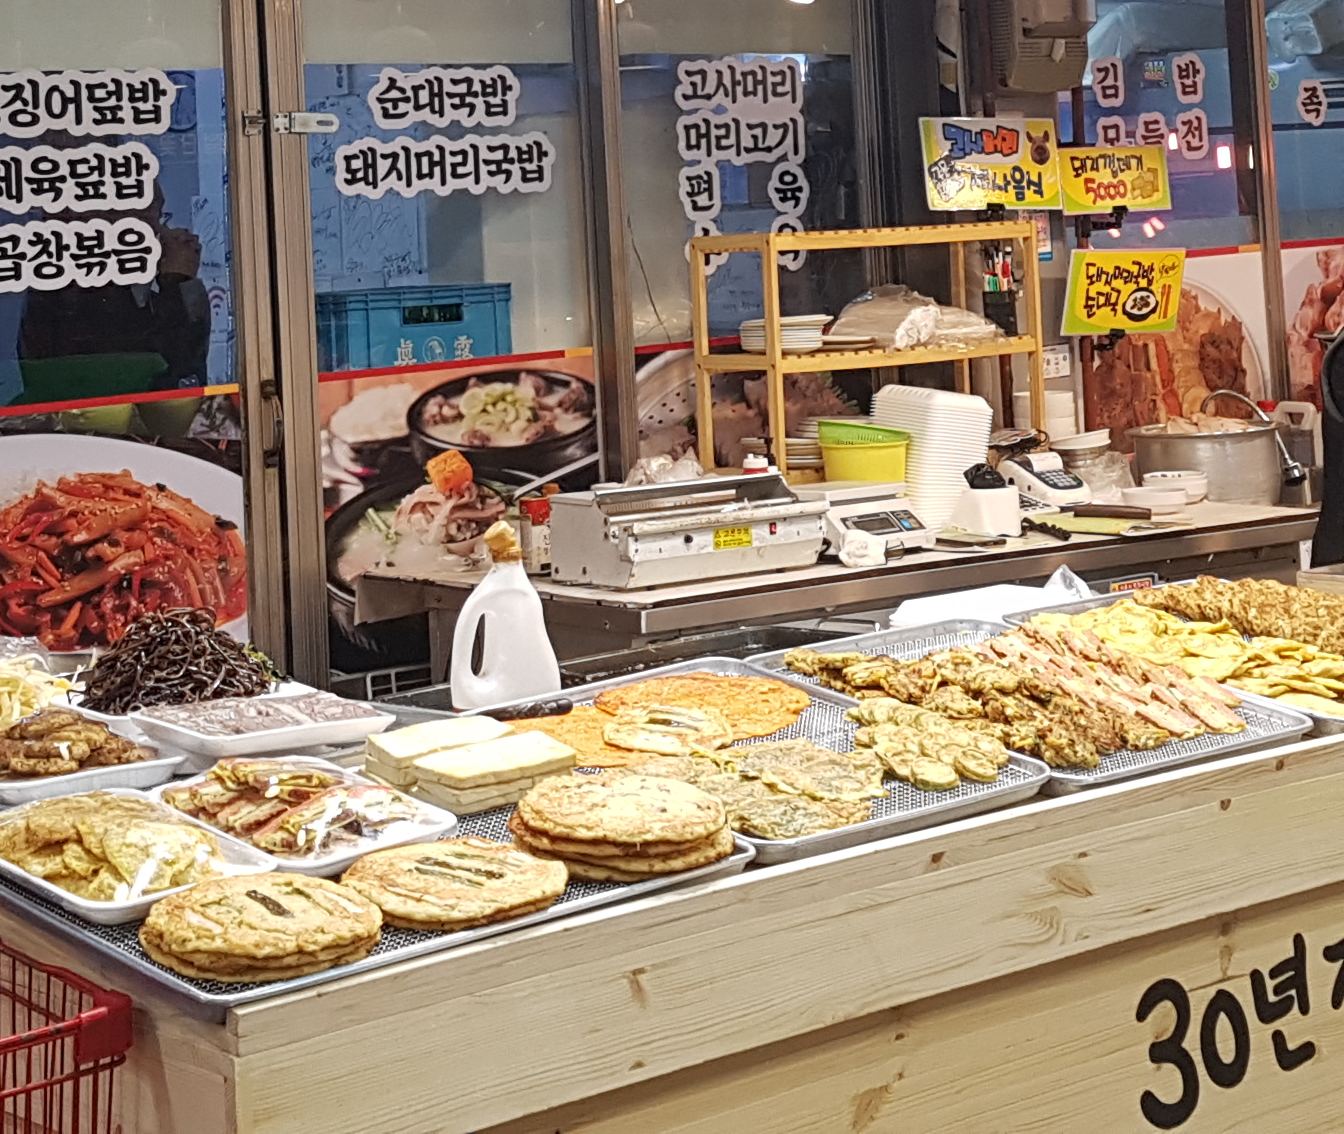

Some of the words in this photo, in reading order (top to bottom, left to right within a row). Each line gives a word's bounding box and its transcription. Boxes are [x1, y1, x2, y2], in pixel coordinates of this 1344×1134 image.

[374, 72, 513, 120] 순대국밥
[681, 63, 798, 104] 고사머리
[684, 117, 800, 158] 머리고기
[342, 140, 550, 190] 돼지머리국밥
[1084, 177, 1128, 206] 5000
